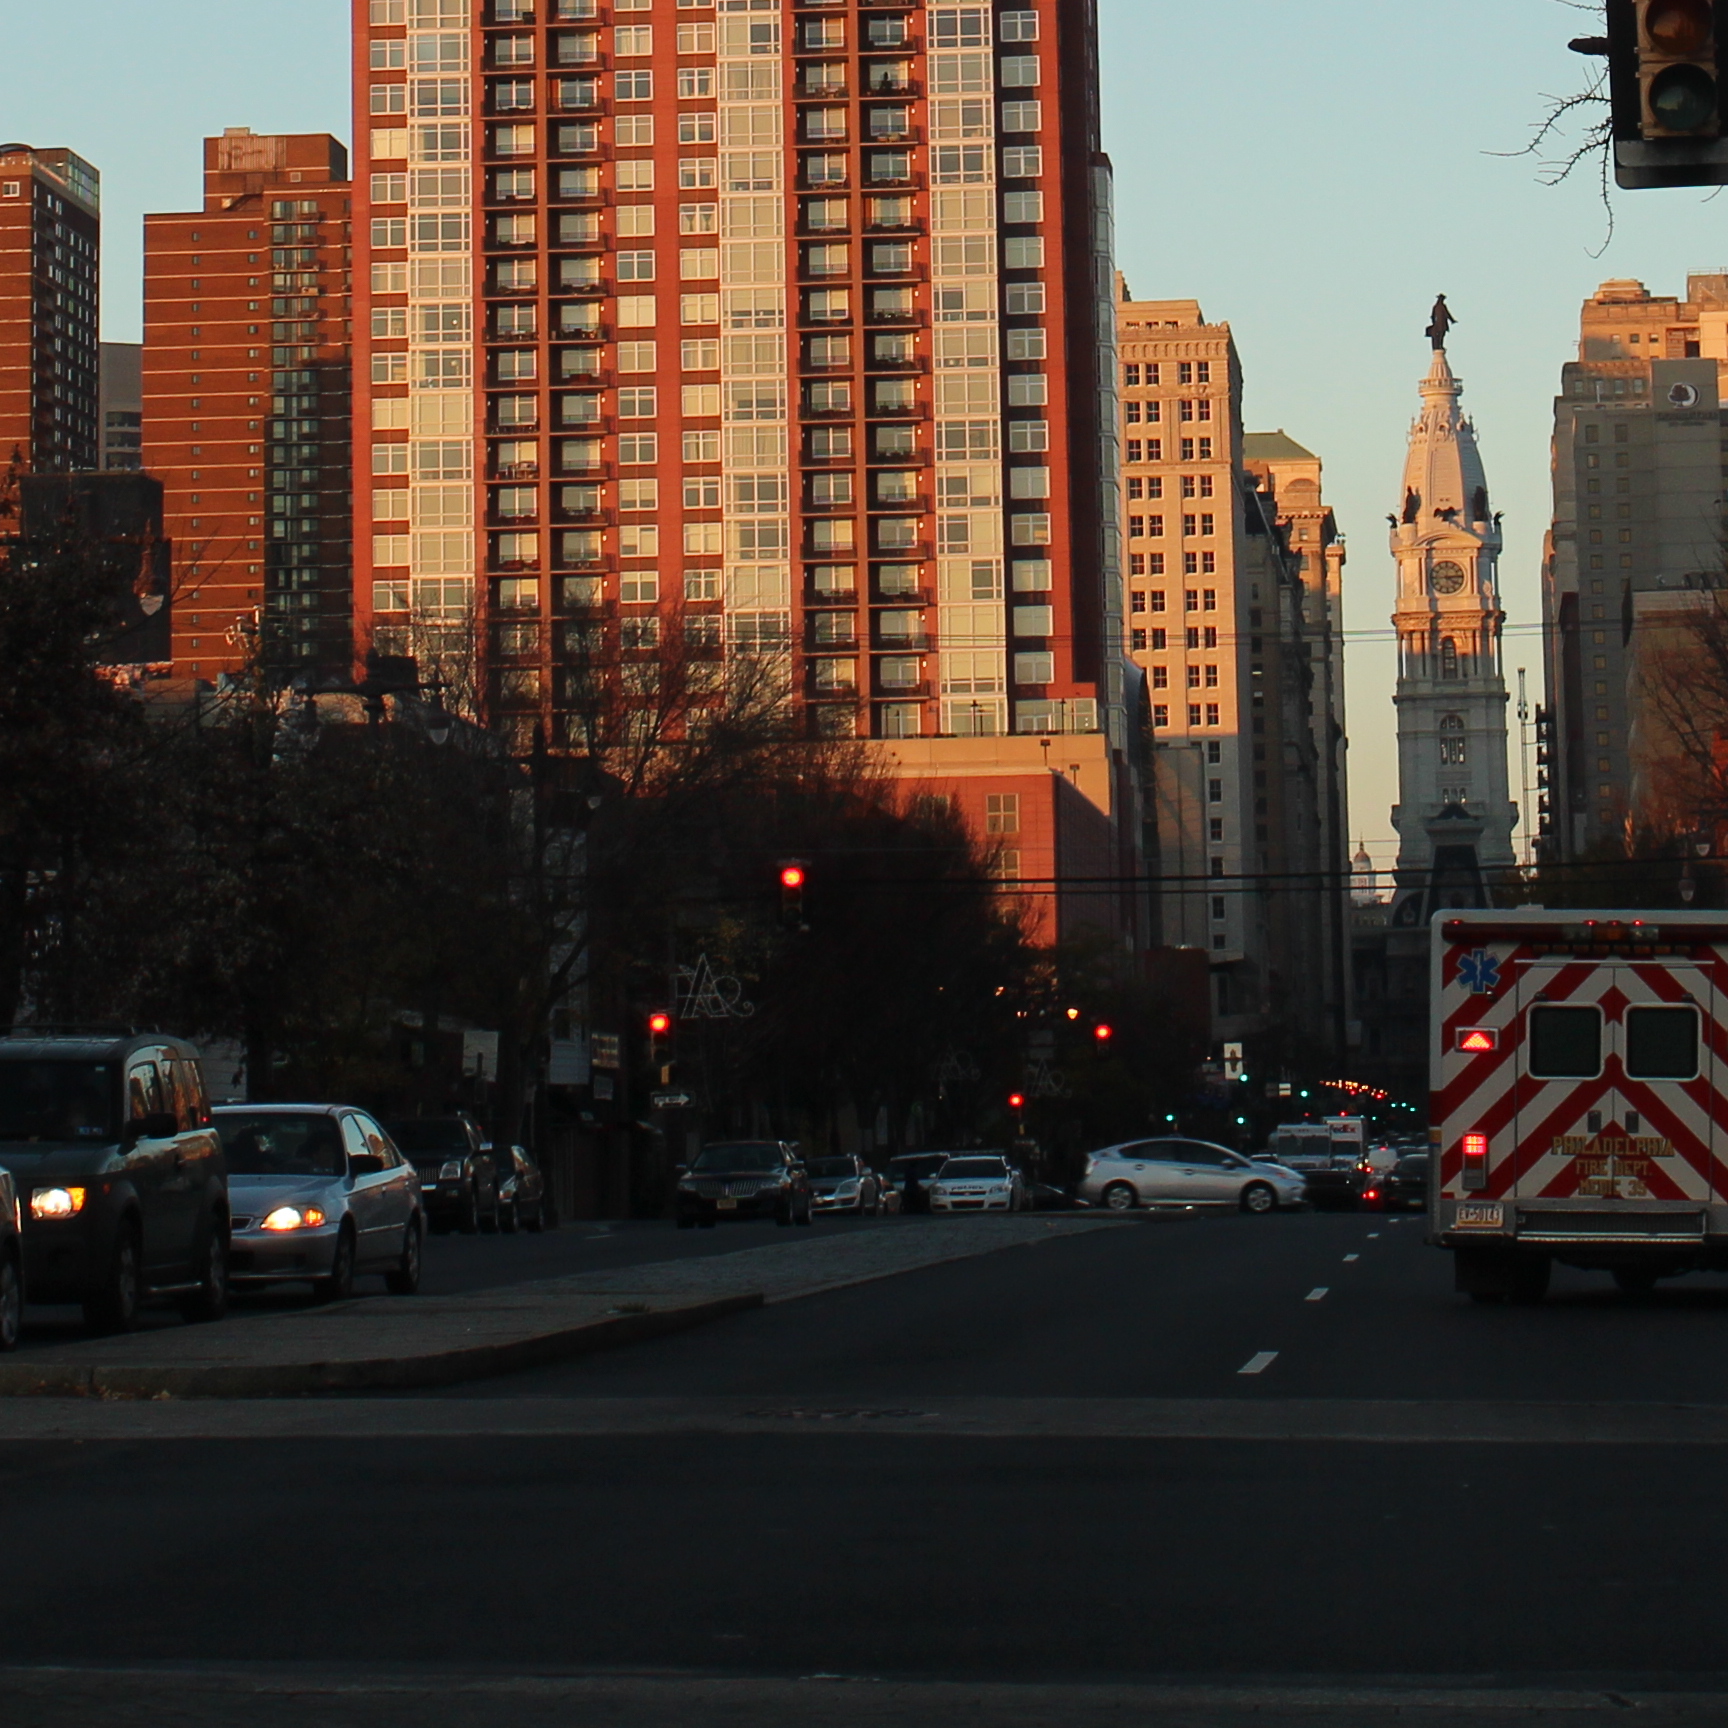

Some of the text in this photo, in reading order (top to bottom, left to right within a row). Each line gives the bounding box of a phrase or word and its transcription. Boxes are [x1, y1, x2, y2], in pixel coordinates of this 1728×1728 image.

[1551, 1136, 1674, 1156] PHILADELPHIA
[1575, 1160, 1651, 1176] FIRE DEPT.
[1578, 1179, 1621, 1195] MEDIC
